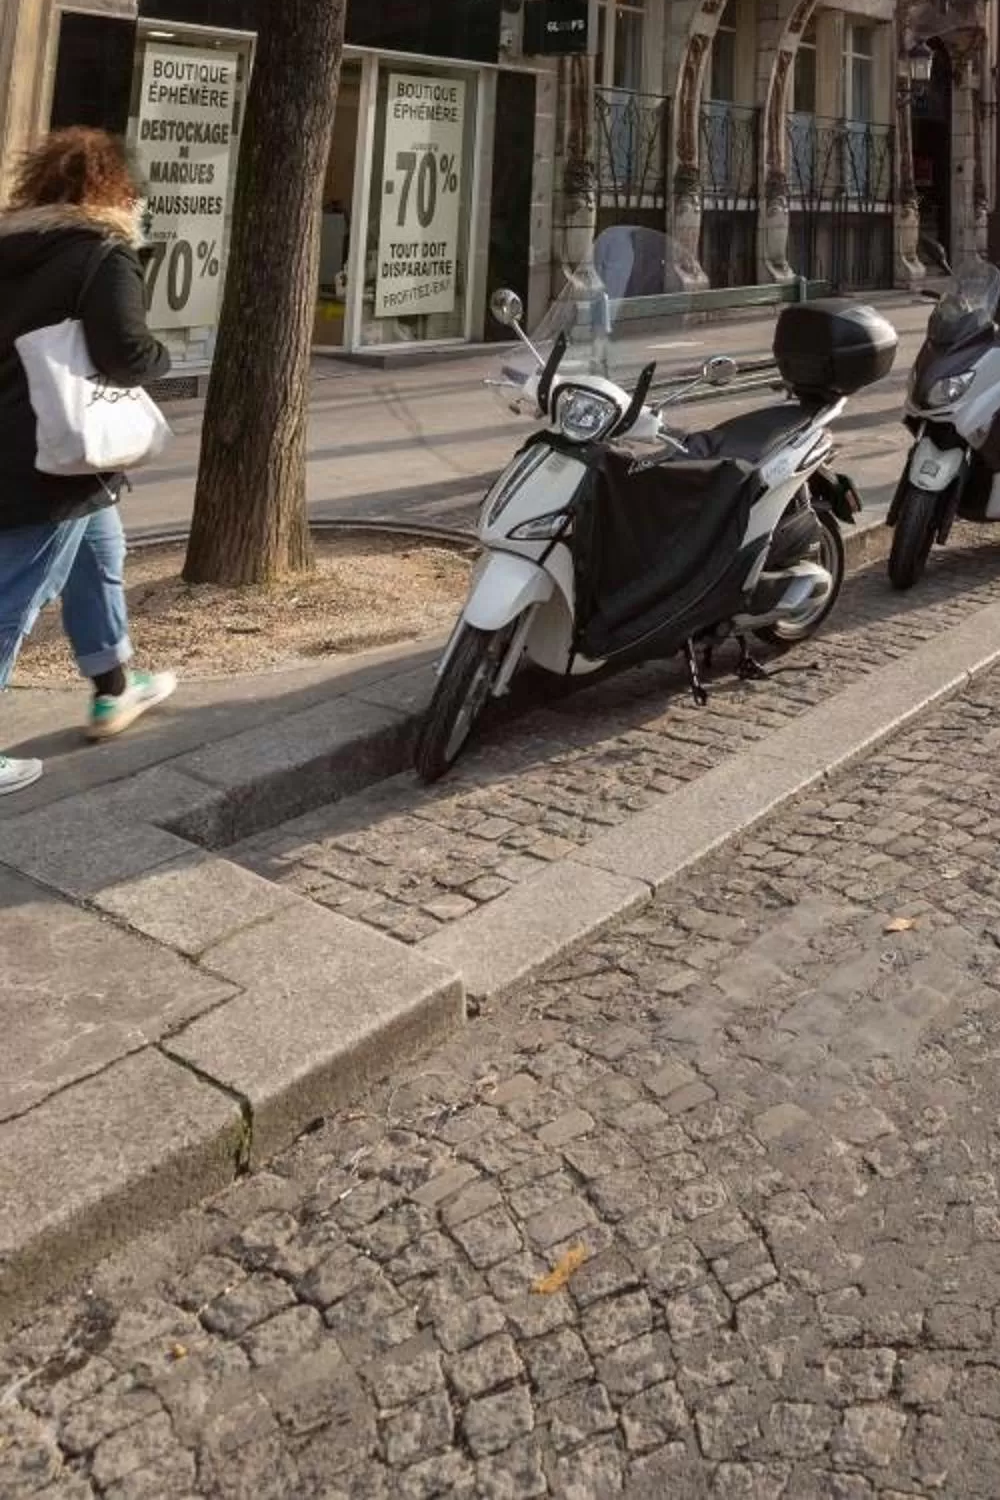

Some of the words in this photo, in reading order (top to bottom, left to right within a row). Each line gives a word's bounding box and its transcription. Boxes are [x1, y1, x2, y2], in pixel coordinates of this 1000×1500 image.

[153, 60, 229, 84] BOUTIQUE
[147, 81, 229, 108] ÉPHÉMÈRE
[396, 82, 457, 103] BOUTIQUE
[140, 119, 229, 145] DESTOCKAGE
[149, 161, 215, 184] MARQUES
[384, 151, 457, 229] -70%
[148, 196, 223, 215] HAUSSURES
[389, 243, 419, 259] TOUT
[421, 242, 447, 258] DOIT
